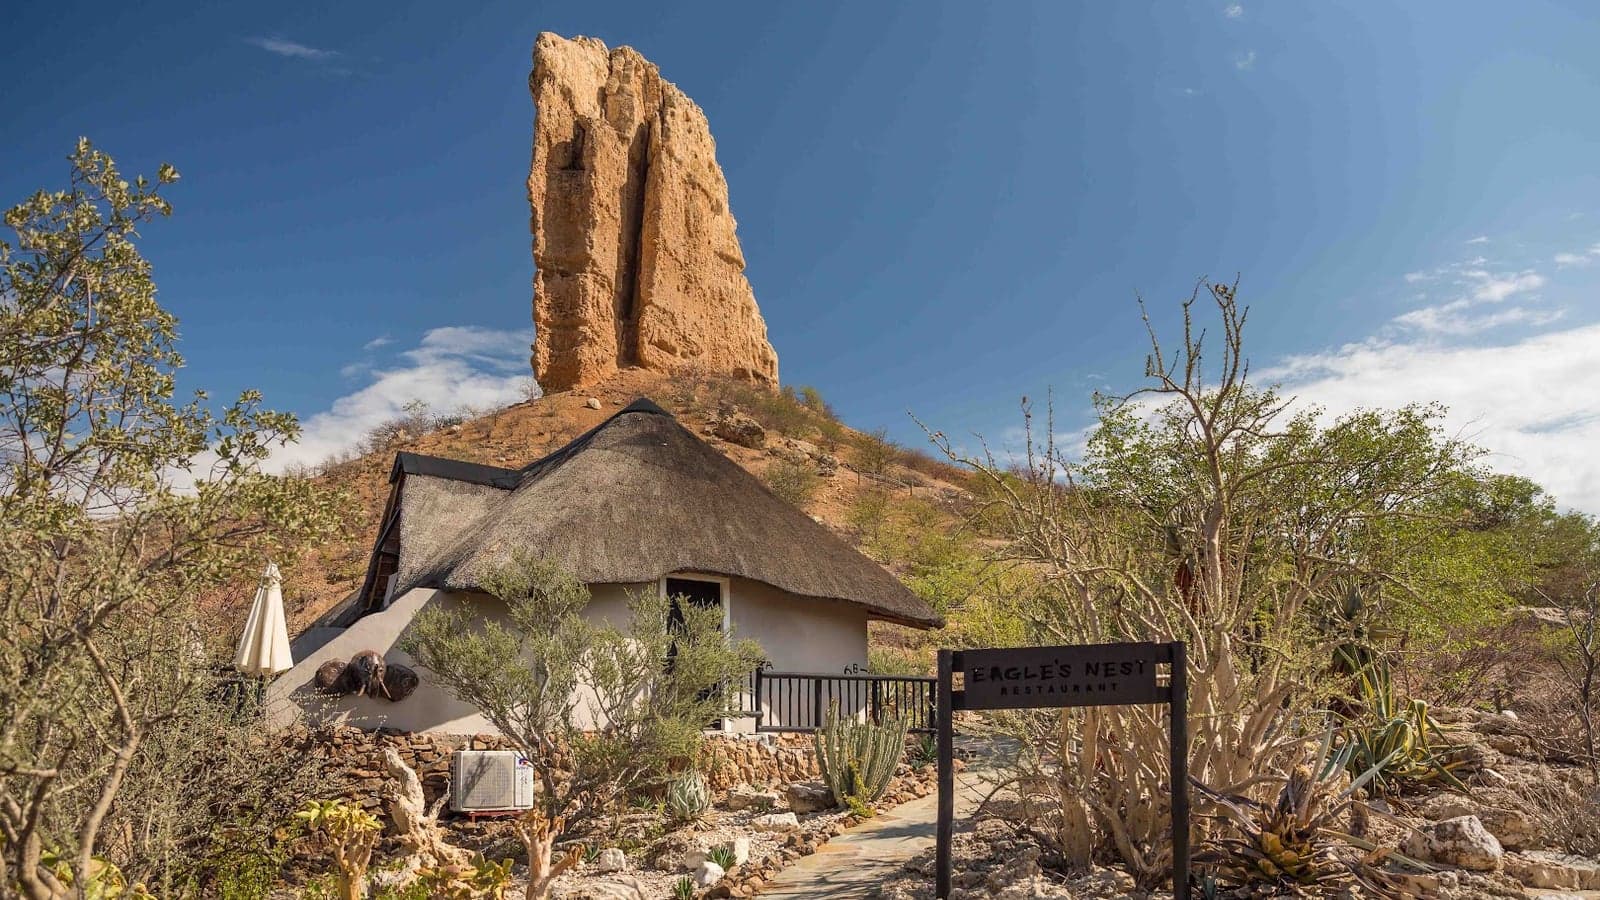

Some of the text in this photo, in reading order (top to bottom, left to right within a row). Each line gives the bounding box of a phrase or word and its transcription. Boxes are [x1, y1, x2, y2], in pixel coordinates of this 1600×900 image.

[972, 659, 1147, 683] EAGLE'S NEST
[1001, 683, 1119, 696] RESTAURANT
